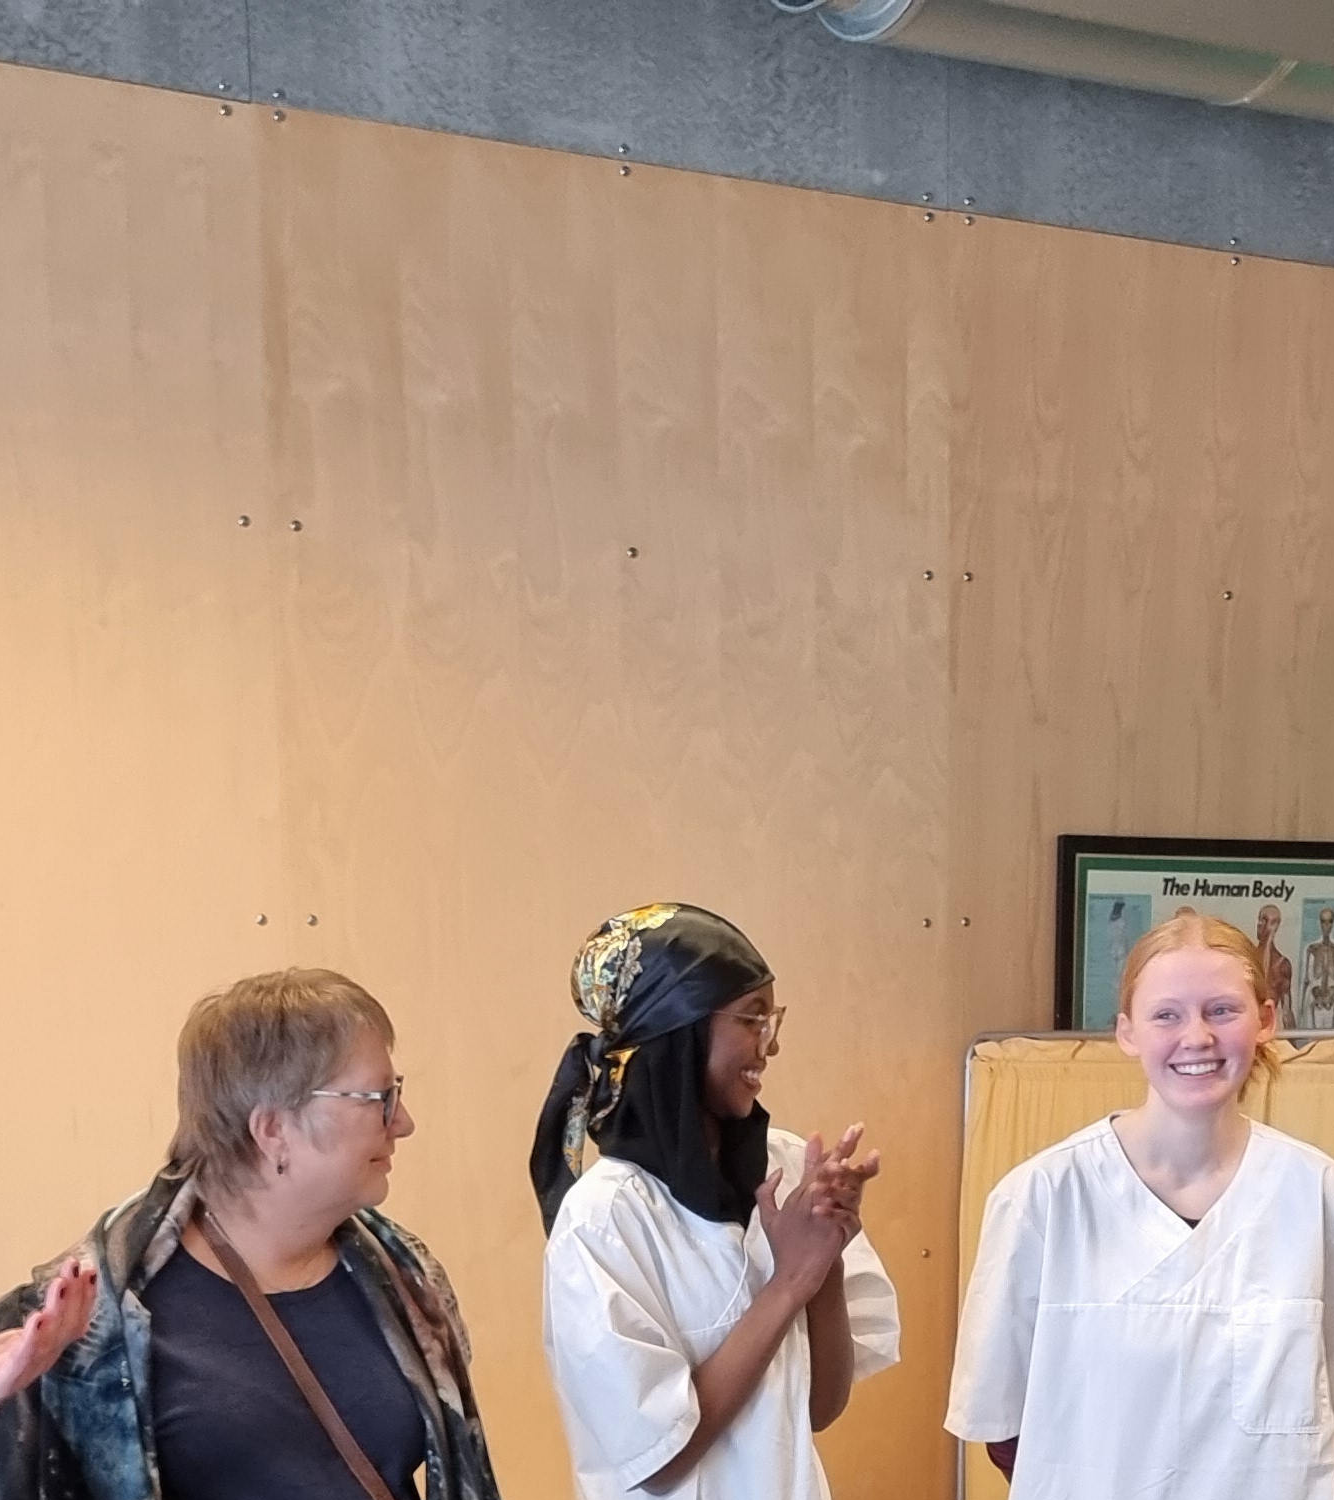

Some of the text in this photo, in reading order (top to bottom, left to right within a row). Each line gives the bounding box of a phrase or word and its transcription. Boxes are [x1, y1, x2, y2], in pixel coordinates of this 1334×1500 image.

[1163, 876, 1295, 902] The Human Body
